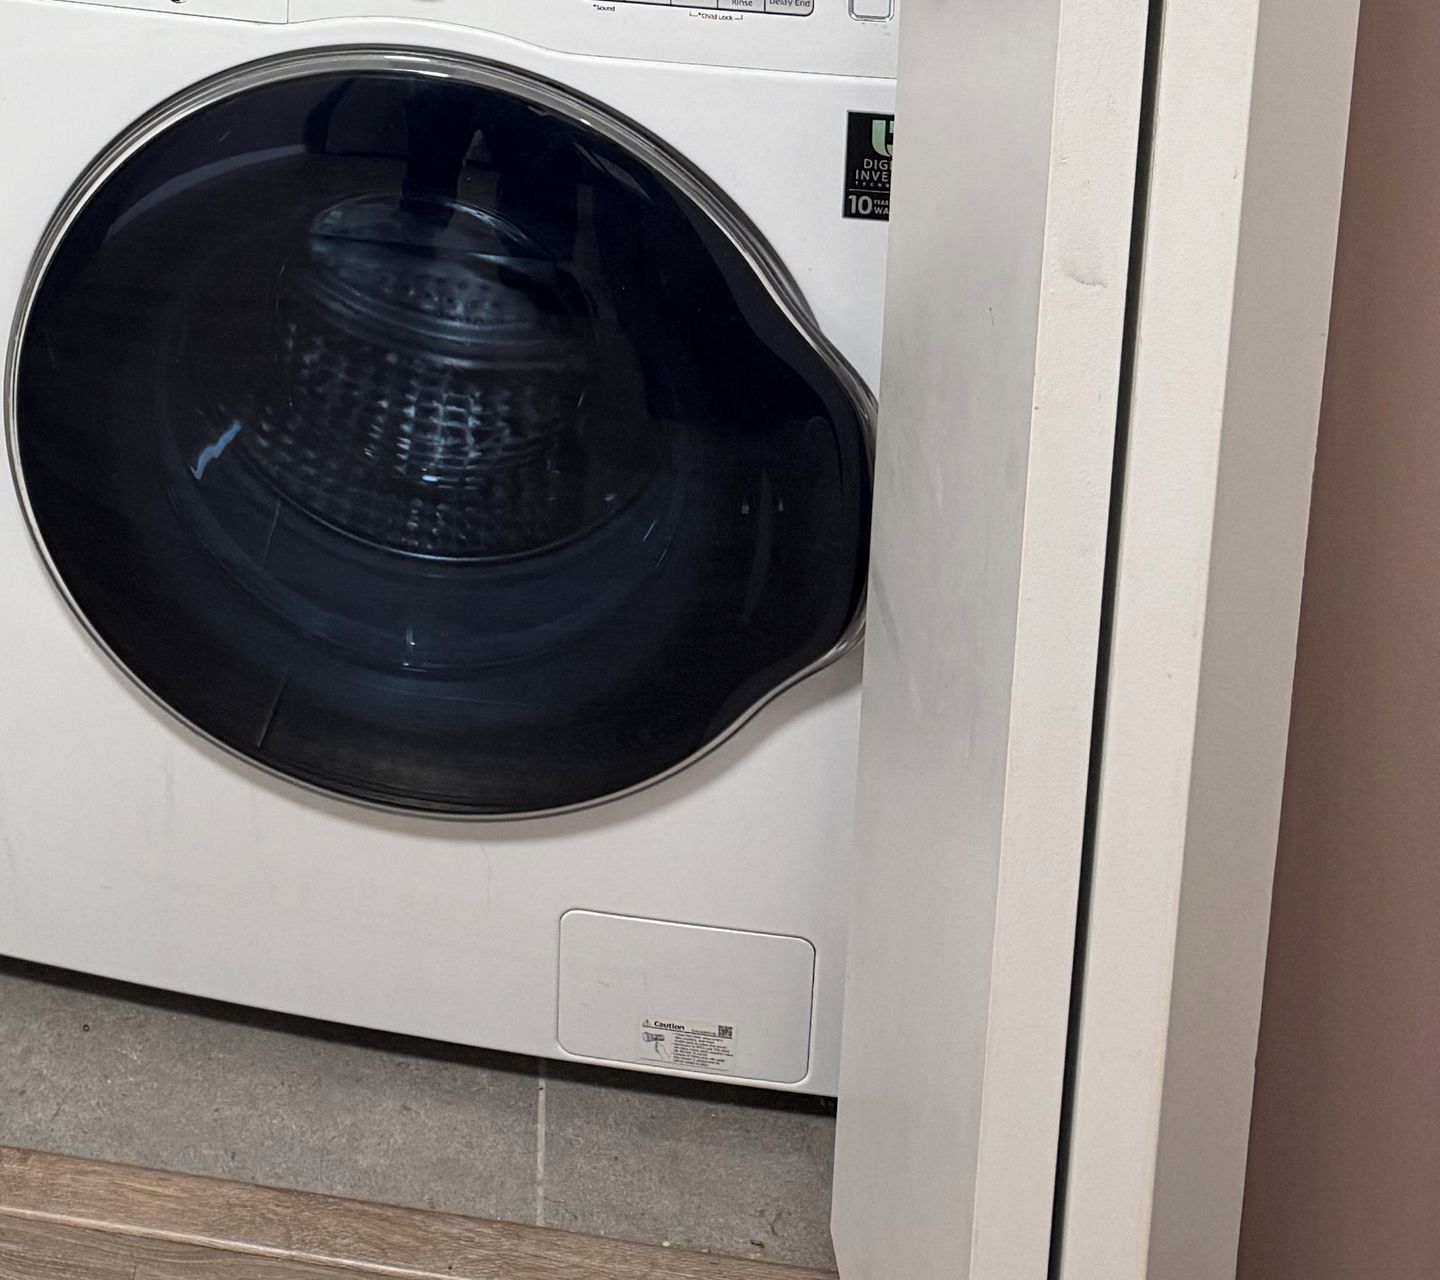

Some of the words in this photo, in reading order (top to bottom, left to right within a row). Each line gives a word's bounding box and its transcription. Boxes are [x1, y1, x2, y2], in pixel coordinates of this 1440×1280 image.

[795, 0, 810, 7] End
[855, 169, 889, 182] INVE
[848, 194, 873, 215] 10
[654, 1020, 685, 1031] Caution
